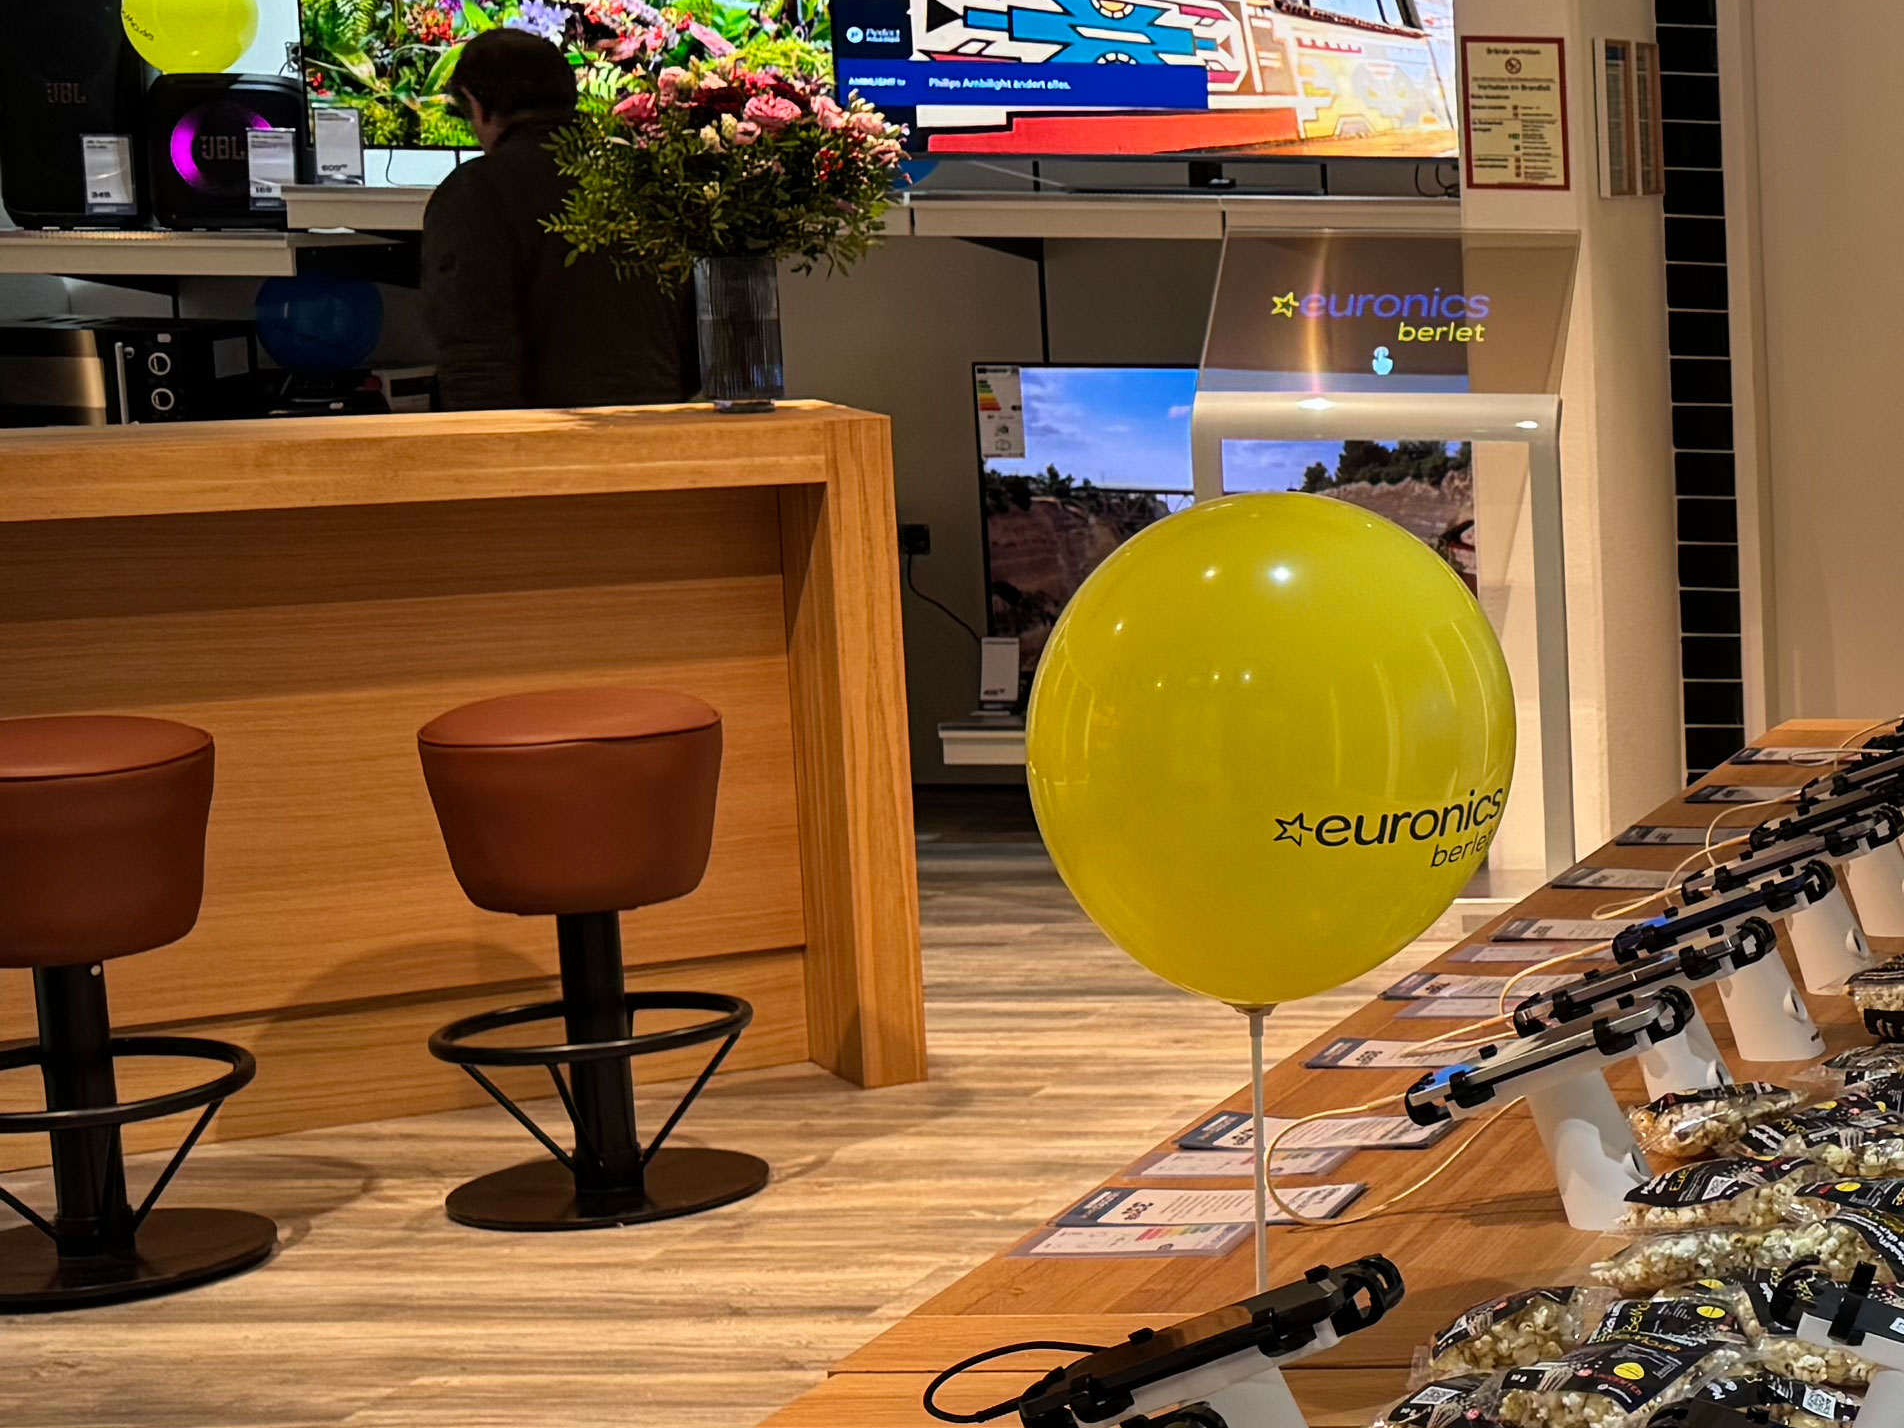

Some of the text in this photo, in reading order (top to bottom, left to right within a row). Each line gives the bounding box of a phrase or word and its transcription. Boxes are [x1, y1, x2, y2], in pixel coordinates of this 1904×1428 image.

[200, 134, 246, 161] JBL
[1300, 286, 1491, 323] euronics
[1397, 320, 1487, 345] berlet
[1314, 787, 1503, 847] euronics
